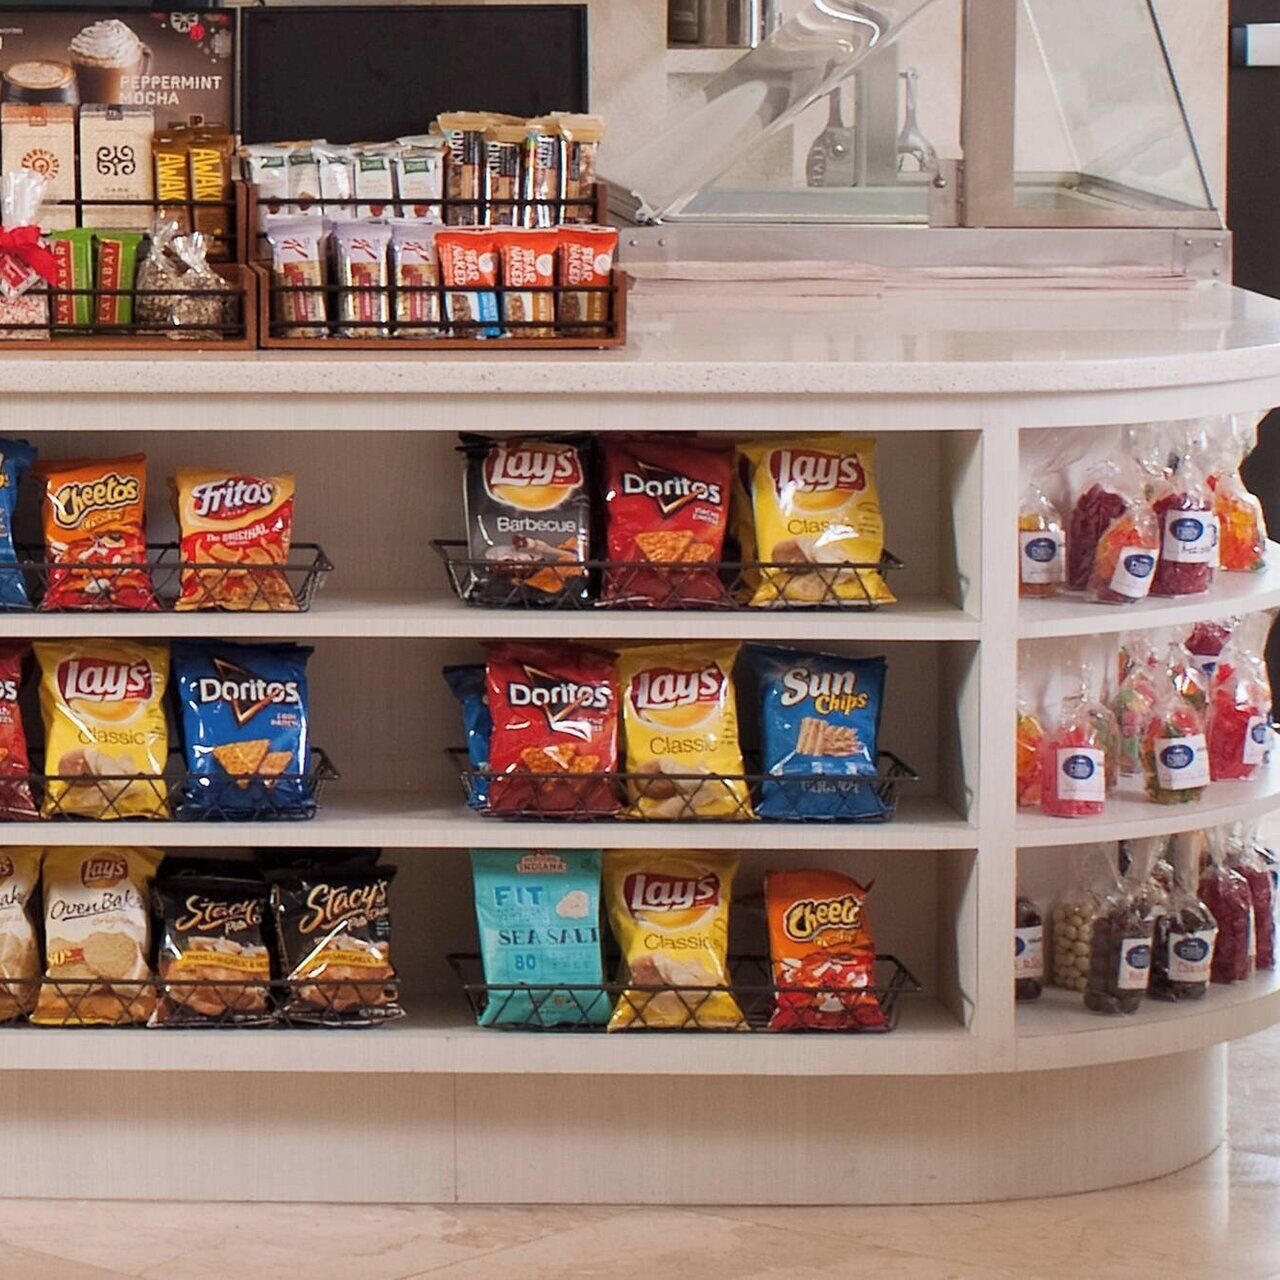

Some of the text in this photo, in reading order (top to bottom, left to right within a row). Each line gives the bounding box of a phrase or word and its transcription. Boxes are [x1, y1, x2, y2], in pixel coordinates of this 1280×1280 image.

[120, 76, 222, 89] PEPPERMINT
[120, 92, 180, 105] MOCHA
[452, 130, 464, 166] KIND
[490, 143, 501, 177] KIND
[192, 479, 275, 516] Fritos
[624, 472, 722, 504] Doritos
[54, 477, 139, 524] Cheetos
[497, 517, 576, 533] Barbecue
[199, 678, 299, 703] Doritos
[509, 683, 612, 709] Doritos
[780, 667, 856, 706] Sun
[814, 692, 868, 715] Chips
[650, 737, 717, 756] Classic
[495, 886, 542, 906] FIT
[51, 898, 101, 920] Oven
[499, 929, 541, 945] SEA
[515, 954, 536, 970] 80
